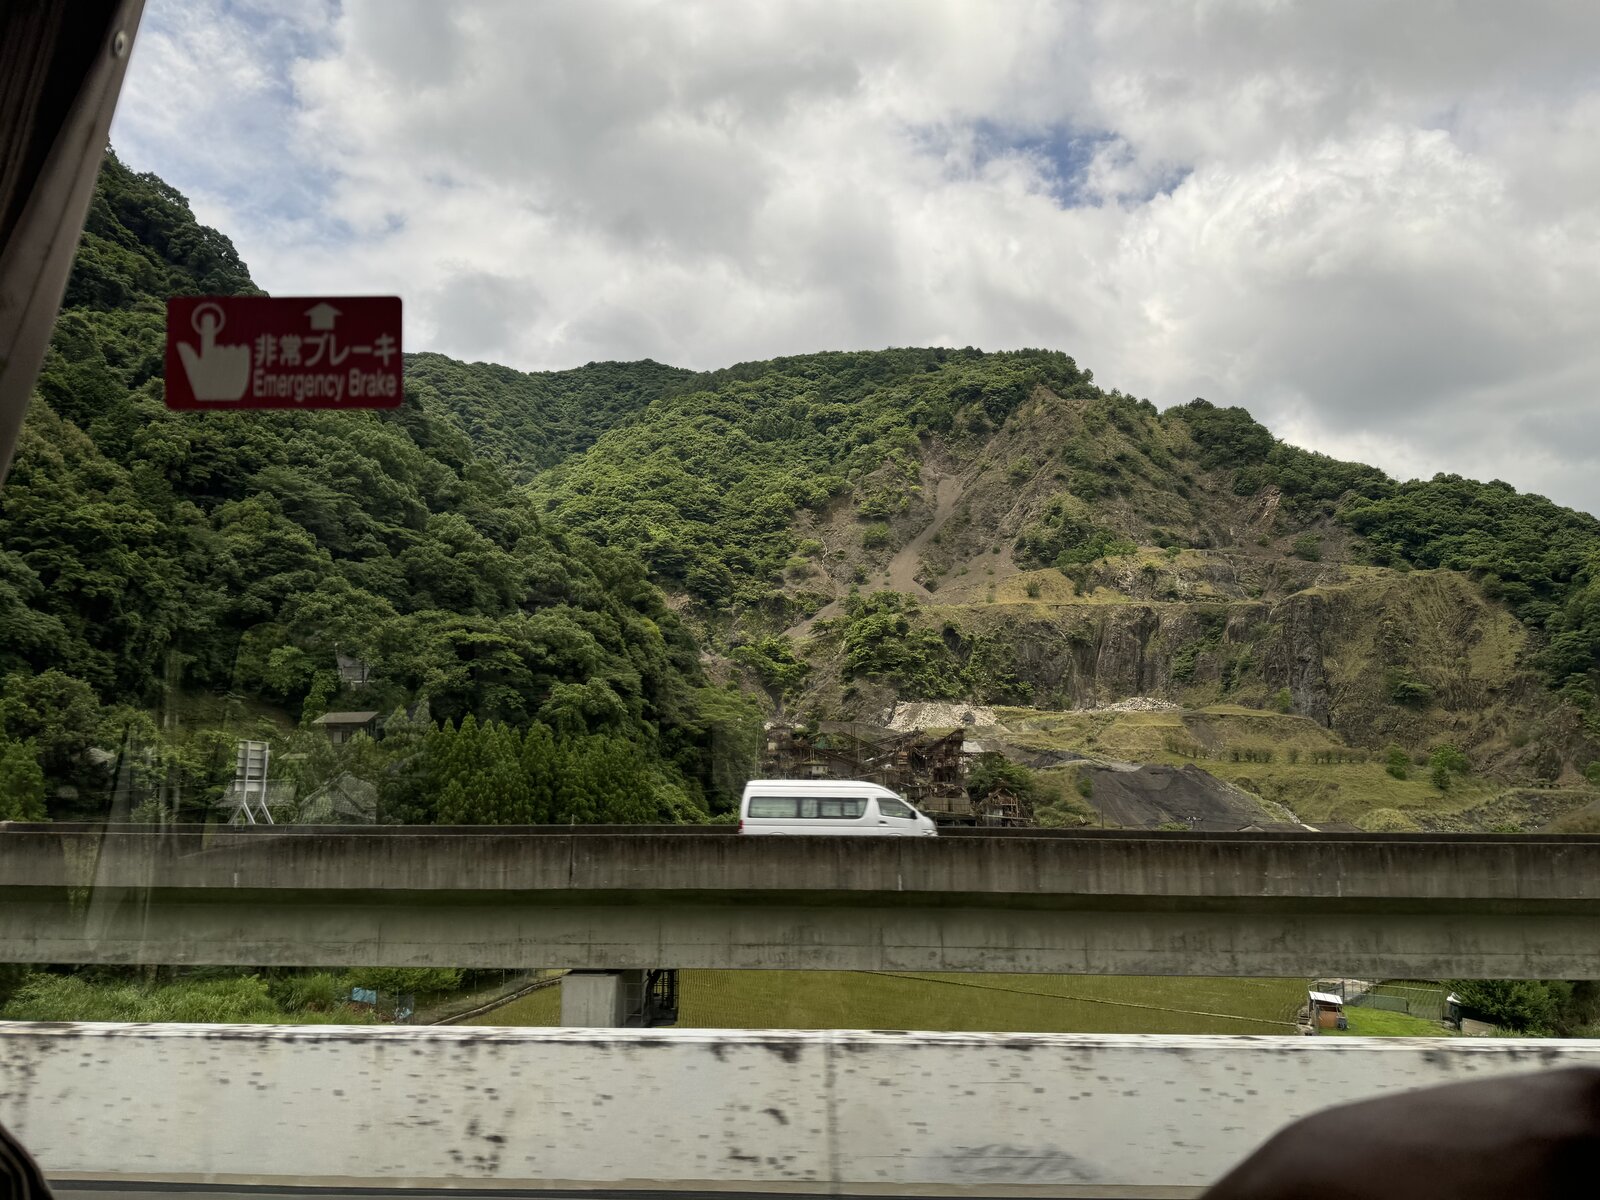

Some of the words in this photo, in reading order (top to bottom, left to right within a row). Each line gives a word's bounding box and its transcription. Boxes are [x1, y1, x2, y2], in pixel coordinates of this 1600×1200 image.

[254, 333, 397, 367] 非常ブレーキ
[252, 368, 345, 402] Emergency
[349, 368, 397, 397] Brake
